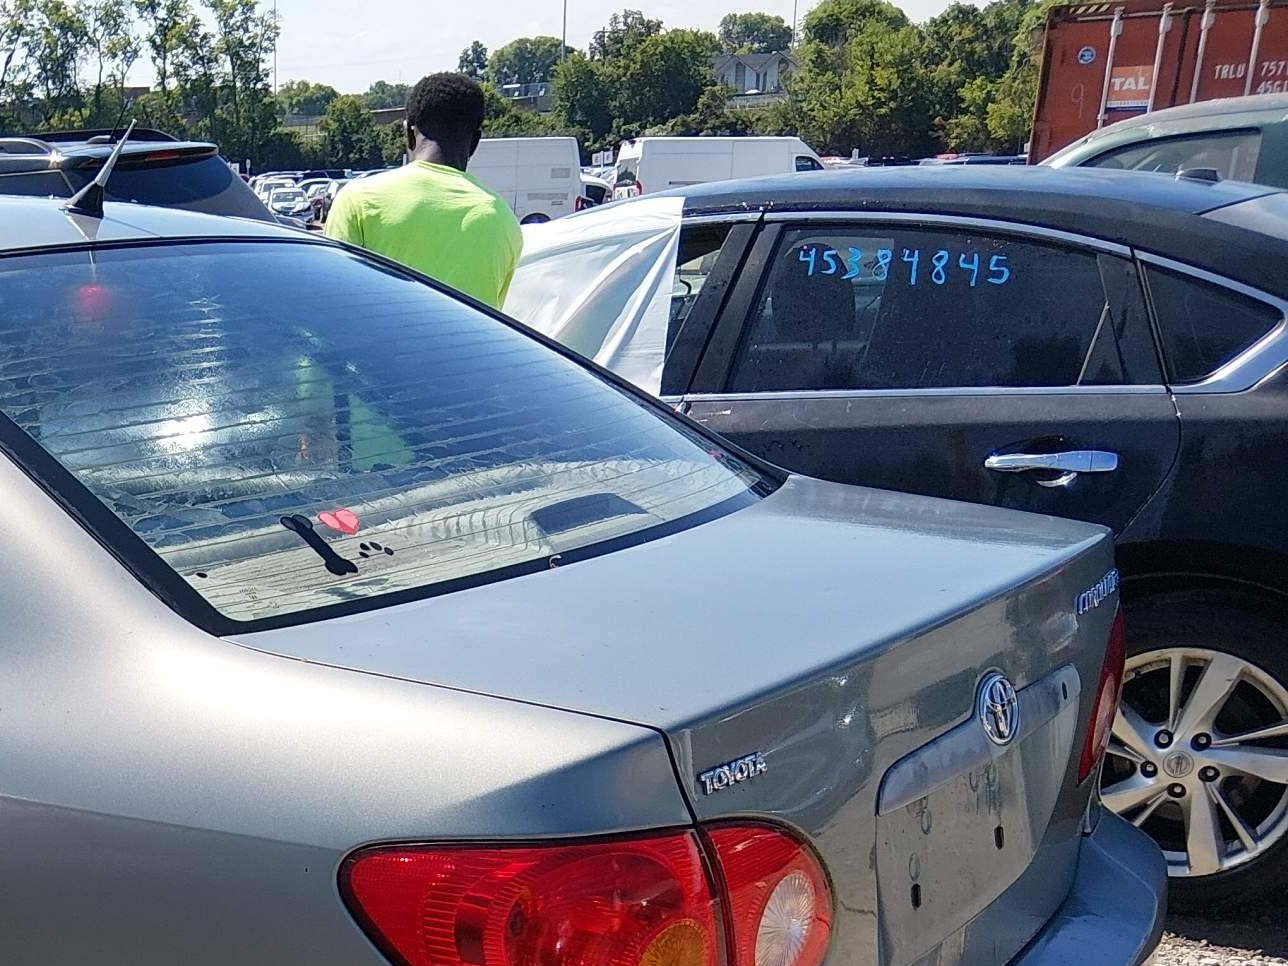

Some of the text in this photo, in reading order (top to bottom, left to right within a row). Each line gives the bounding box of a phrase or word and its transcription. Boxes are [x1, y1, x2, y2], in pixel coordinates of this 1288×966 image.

[1111, 77, 1150, 91] TAL
[1214, 60, 1288, 80] TRLU 757
[798, 247, 1010, 287] 45384845
[698, 752, 768, 795] TOYOTA
